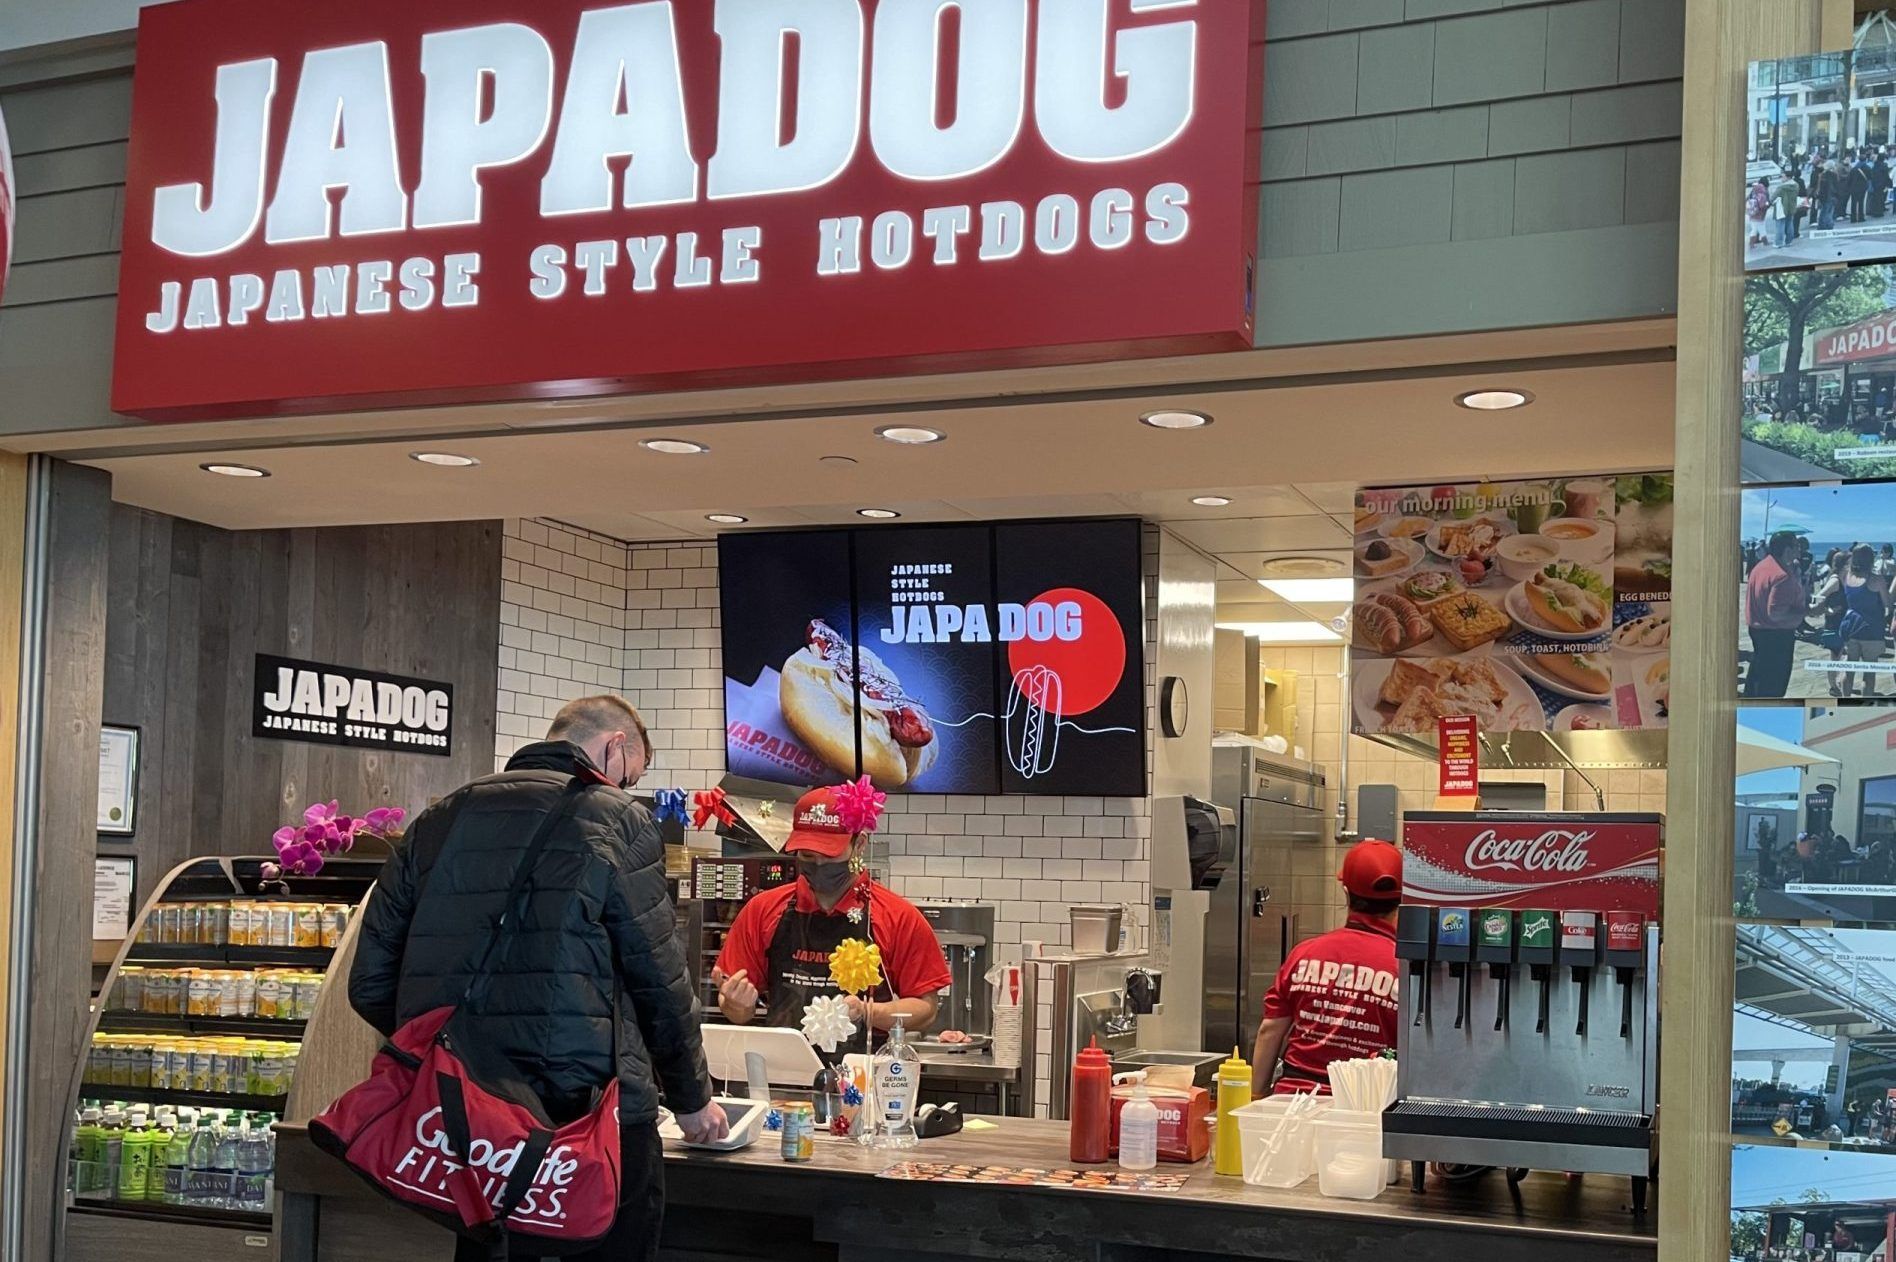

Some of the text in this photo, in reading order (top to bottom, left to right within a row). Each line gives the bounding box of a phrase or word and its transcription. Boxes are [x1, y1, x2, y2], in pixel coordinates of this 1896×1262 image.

[152, 0, 1197, 258] JAPADOG
[145, 183, 1190, 333] JAPANESE STYLE HOTDOGS
[1365, 491, 1549, 514] our morning menu
[891, 564, 953, 575] JAPANESE
[891, 578, 930, 589] STYLE
[891, 591, 945, 602] HOTDOGS
[1620, 593, 1638, 602] EGG
[263, 667, 449, 731] JAPADOG
[263, 715, 447, 747] JAPANESE STYLE HOTDOGS
[1464, 829, 1598, 872] Coca-Cola
[1568, 925, 1588, 935] Coke
